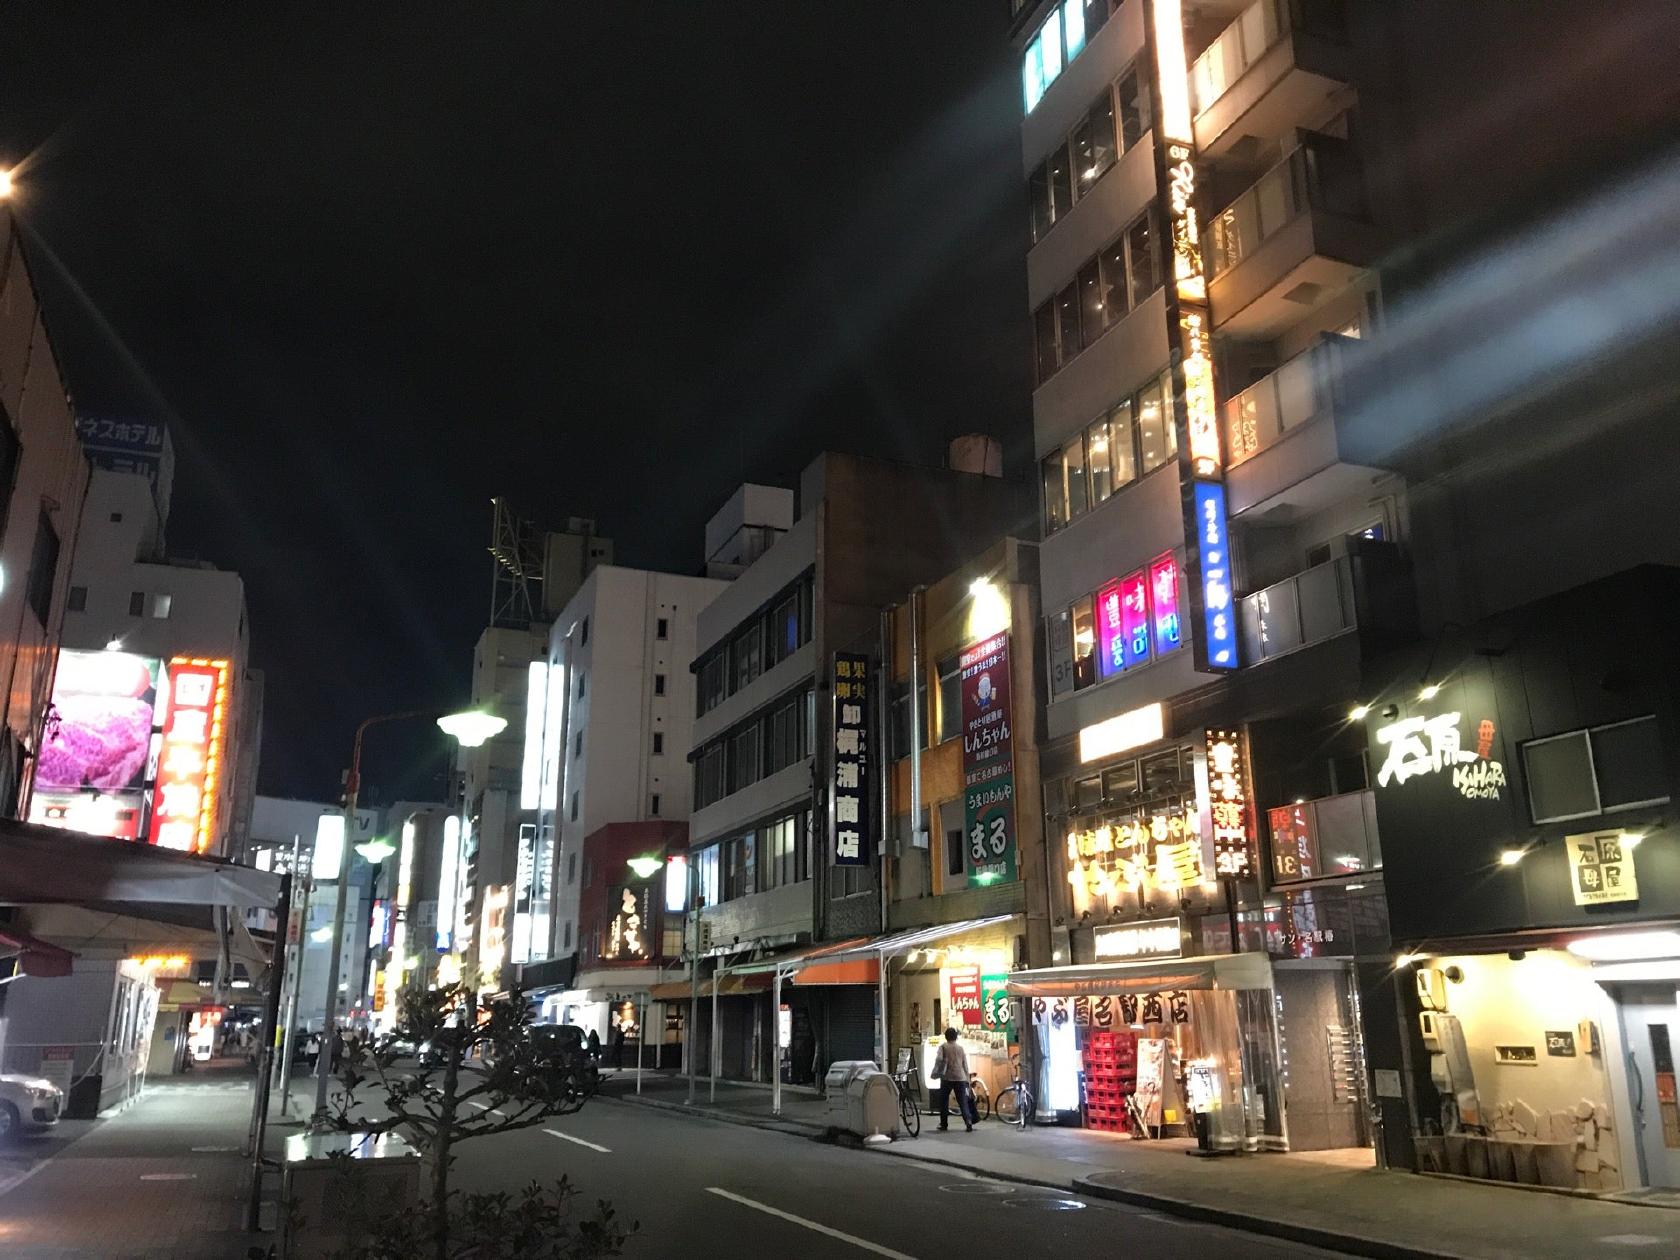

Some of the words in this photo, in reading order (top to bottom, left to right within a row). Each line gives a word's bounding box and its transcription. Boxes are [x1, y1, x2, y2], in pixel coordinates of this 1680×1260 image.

[1055, 660, 1072, 682] 3F
[964, 720, 1011, 754] しんちゃん
[968, 784, 1012, 810] うまいもんや
[970, 816, 1007, 860] まる
[951, 996, 980, 1010] しんちゃん
[984, 998, 1010, 1026] まる
[1032, 990, 1190, 1025] やぶ屋名駅西店
